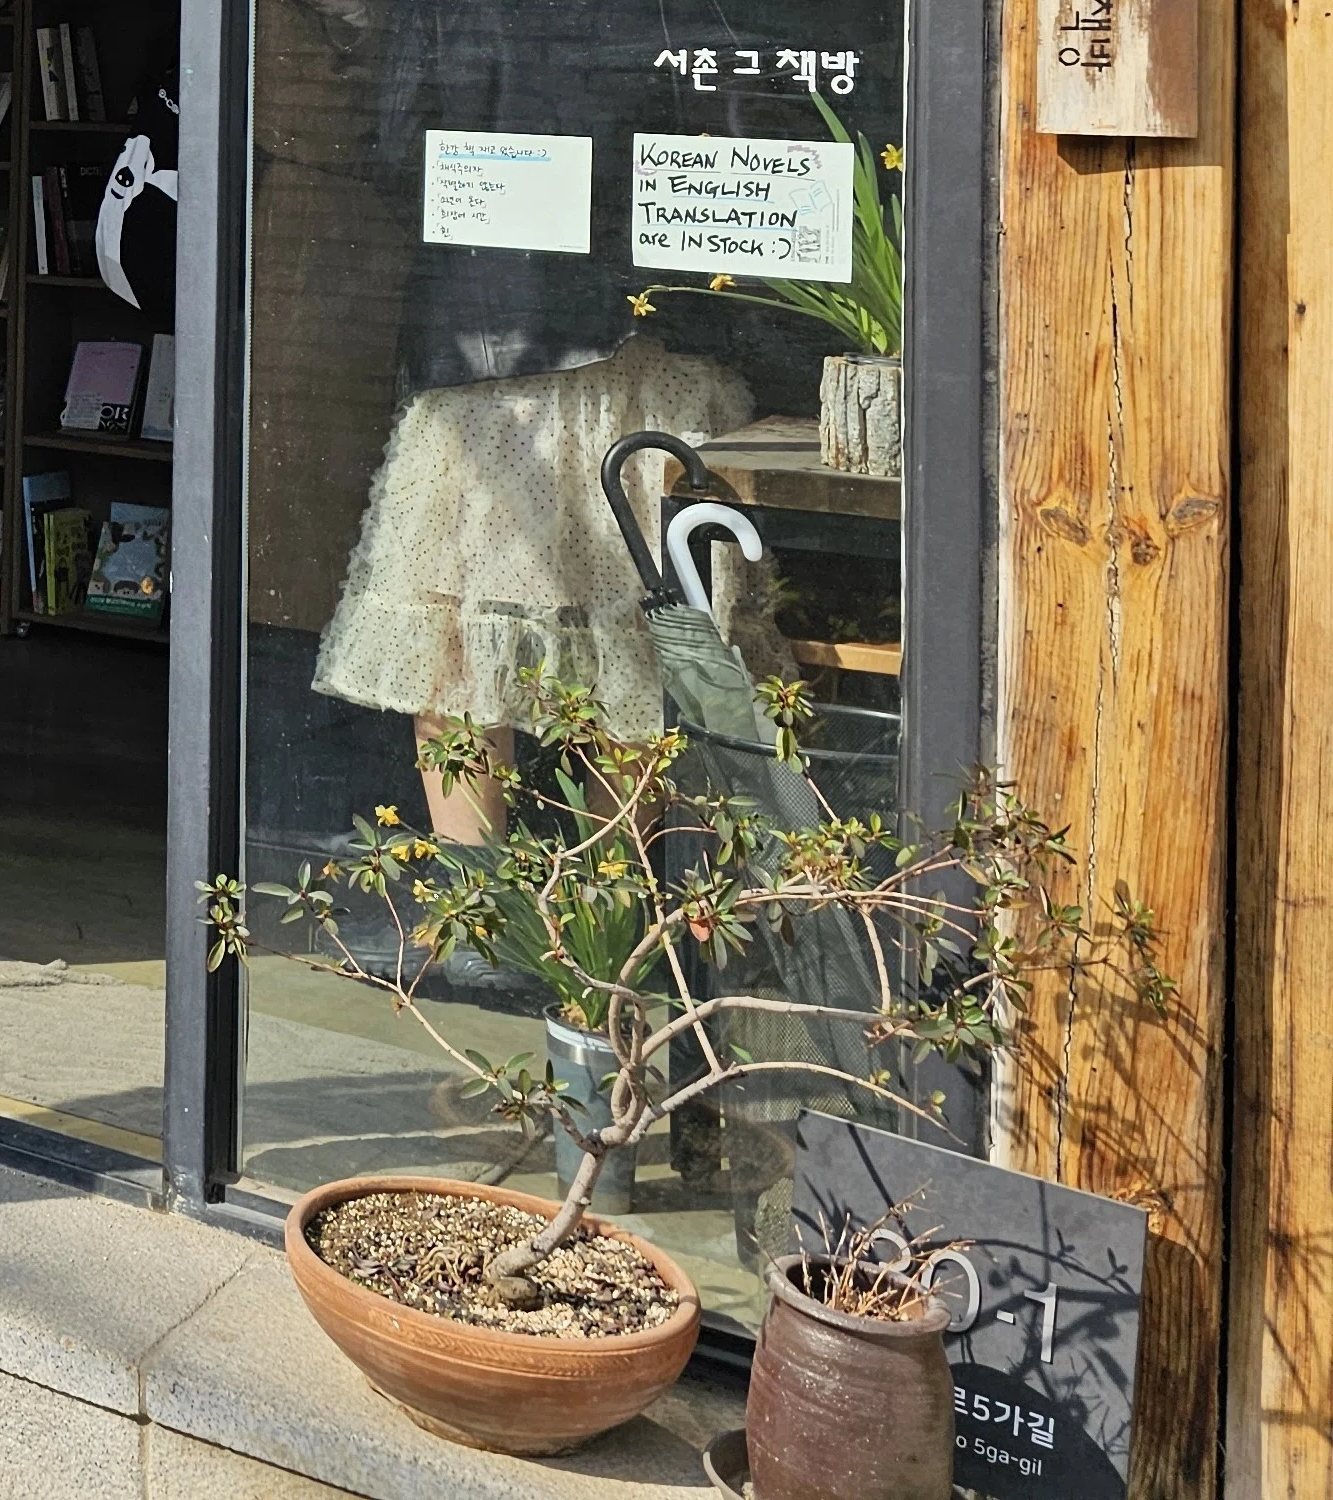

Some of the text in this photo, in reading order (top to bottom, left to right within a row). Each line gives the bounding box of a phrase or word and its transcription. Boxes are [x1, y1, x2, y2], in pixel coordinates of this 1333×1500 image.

[653, 48, 860, 95] 서촌 그 책방
[640, 142, 811, 176] KOREAN NOVELS
[639, 175, 771, 201] IN ENGLISH
[638, 202, 798, 228] TRANSLATION
[639, 232, 671, 248] are
[973, 1437, 1043, 1477] 5ga-gil
